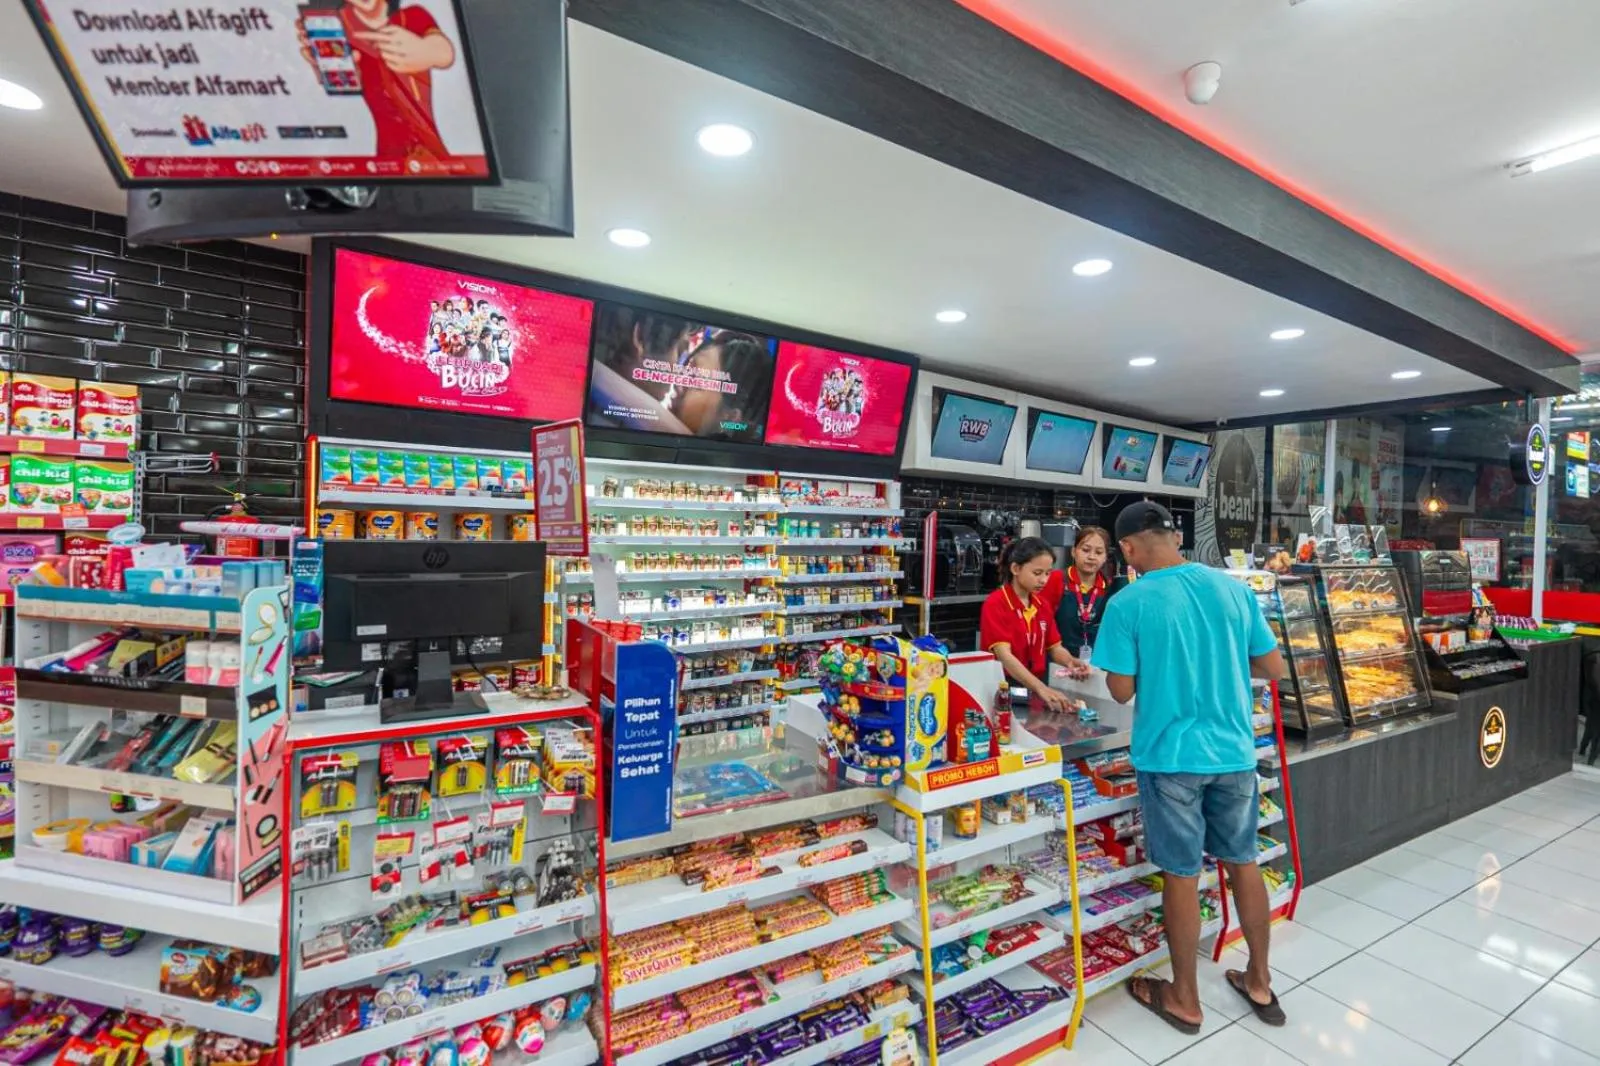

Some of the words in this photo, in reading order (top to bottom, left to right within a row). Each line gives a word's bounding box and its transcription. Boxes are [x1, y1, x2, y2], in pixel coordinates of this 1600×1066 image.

[73, 9, 182, 31] Download
[186, 8, 273, 36] Alfagift
[91, 44, 158, 64] untuk
[158, 43, 200, 69] jadi
[105, 76, 190, 96] Member
[194, 75, 291, 96] Alfamart
[62, 419, 71, 430] 4
[124, 425, 133, 436] 4
[961, 419, 989, 436] RWB
[538, 456, 580, 507] 25%
[1219, 481, 1256, 522] bean!
[624, 697, 662, 709] Pilihan
[624, 710, 661, 724] Tepat
[624, 727, 658, 740] Untuk
[617, 752, 664, 765] Keluarga
[620, 763, 661, 779] Sehat
[932, 771, 964, 785] PROMO
[965, 763, 995, 777] HEBOH
